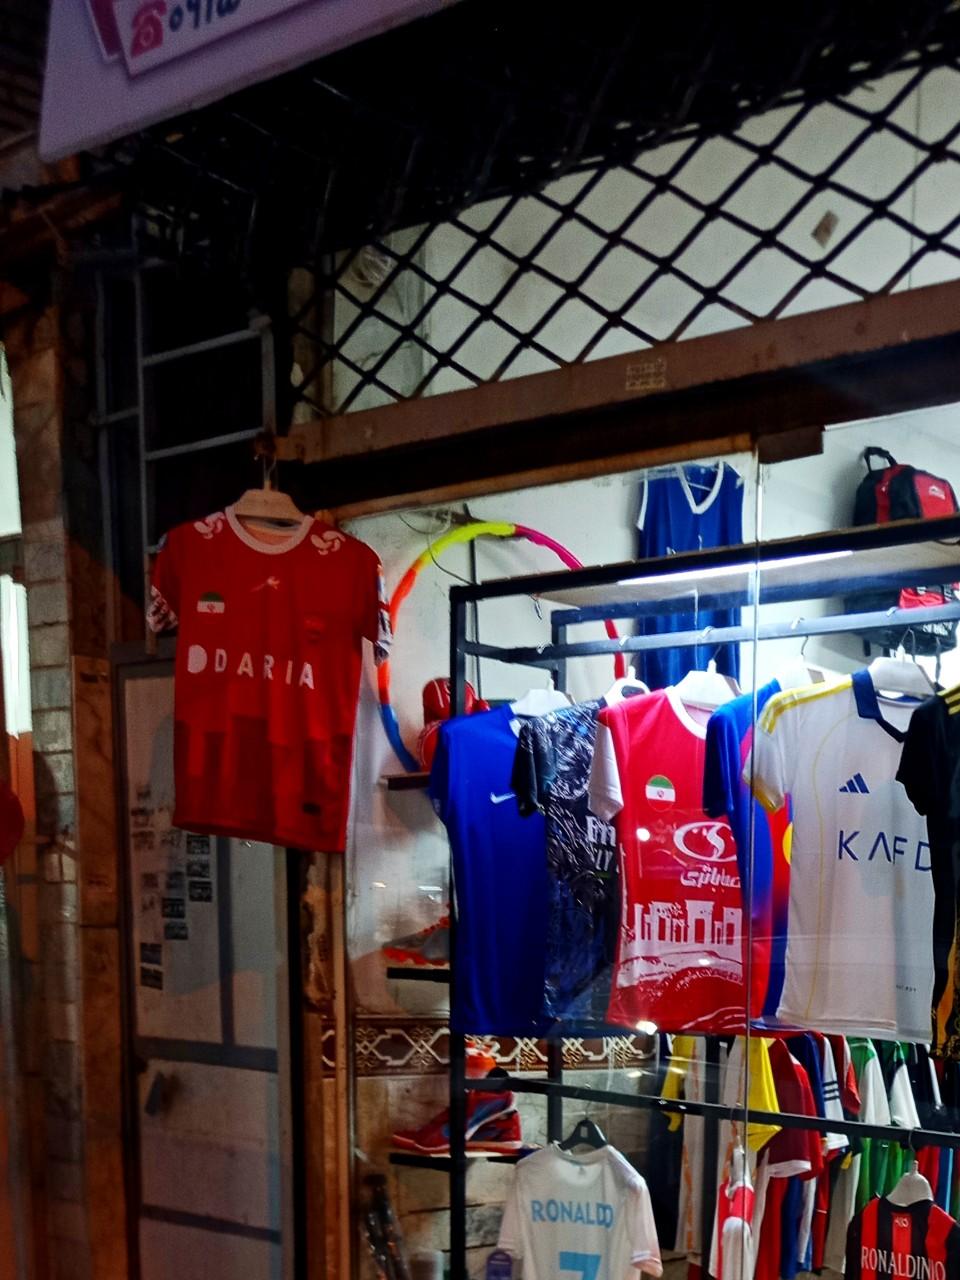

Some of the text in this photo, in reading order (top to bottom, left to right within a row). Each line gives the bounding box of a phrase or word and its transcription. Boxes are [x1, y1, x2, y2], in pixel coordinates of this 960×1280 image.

[215, 648, 315, 690] DARIA
[838, 829, 932, 872] KAFD
[531, 1198, 614, 1230] RONALDO
